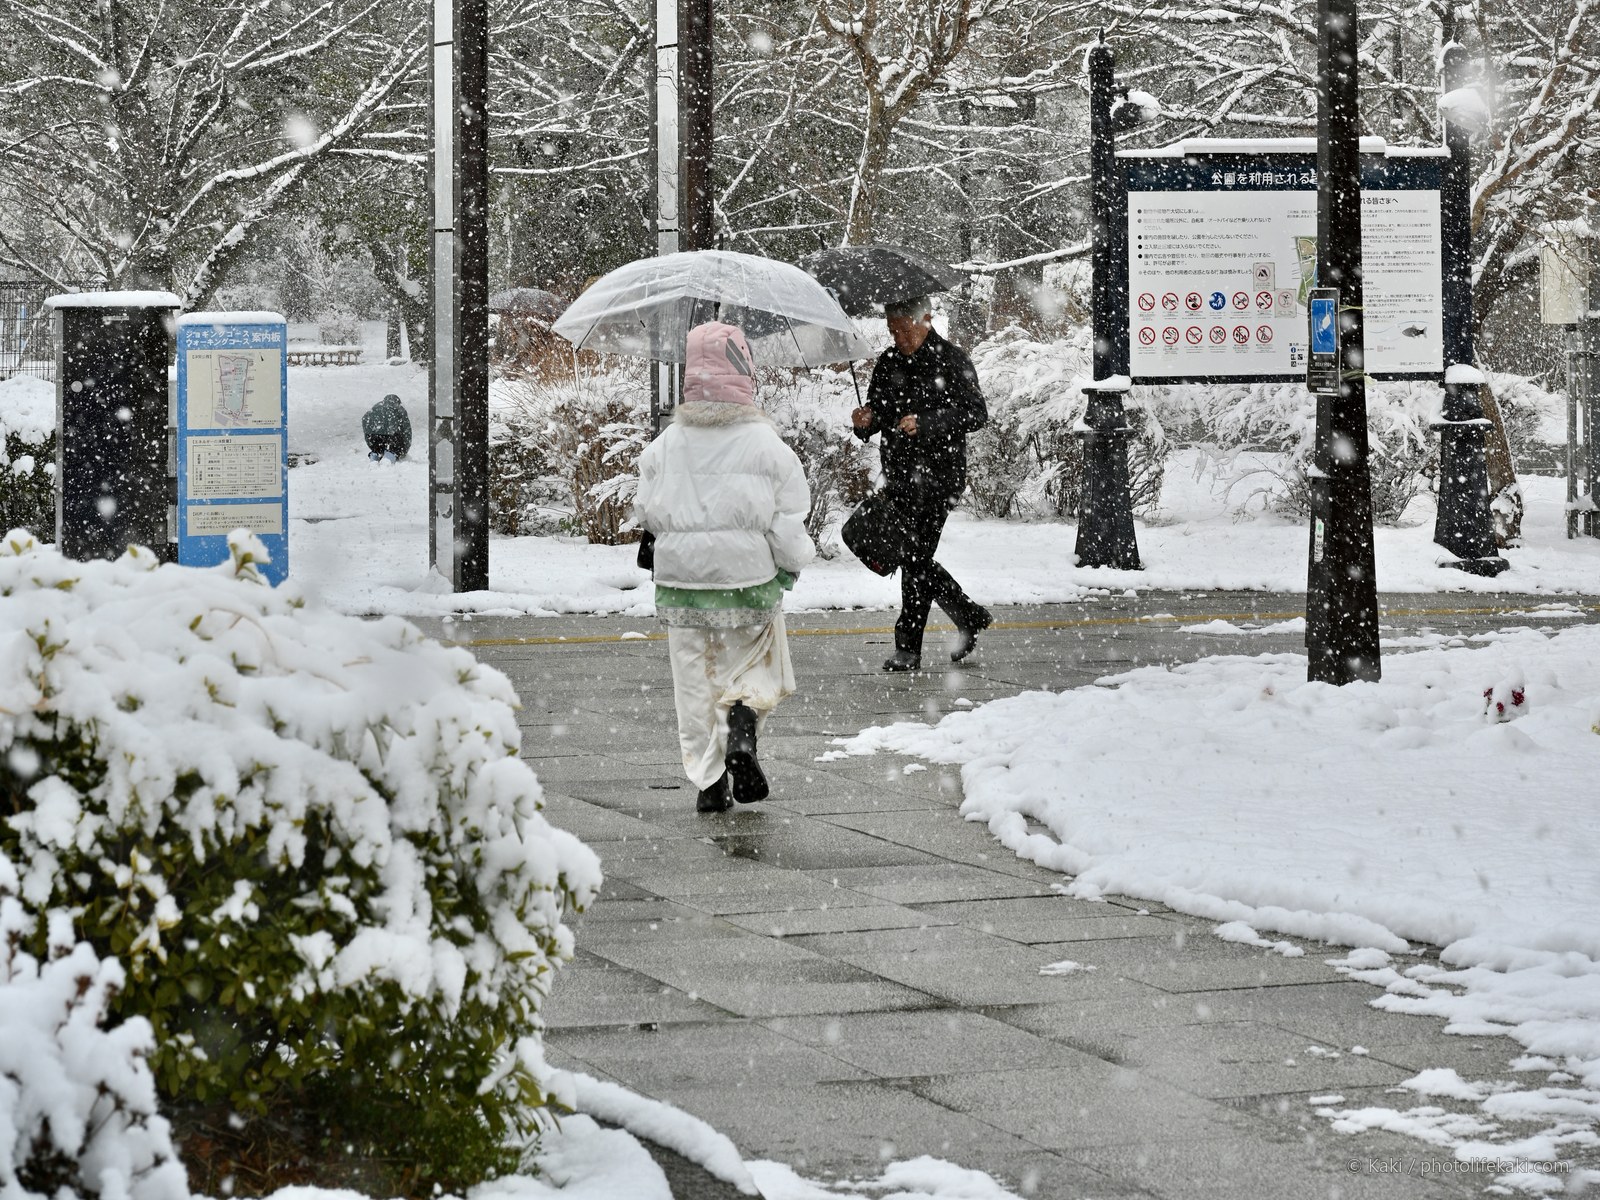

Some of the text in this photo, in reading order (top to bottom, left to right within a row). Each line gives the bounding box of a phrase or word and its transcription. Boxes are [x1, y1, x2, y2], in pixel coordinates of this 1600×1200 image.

[186, 338, 250, 347] ウォーキングコース
[251, 332, 281, 343] 案内板
